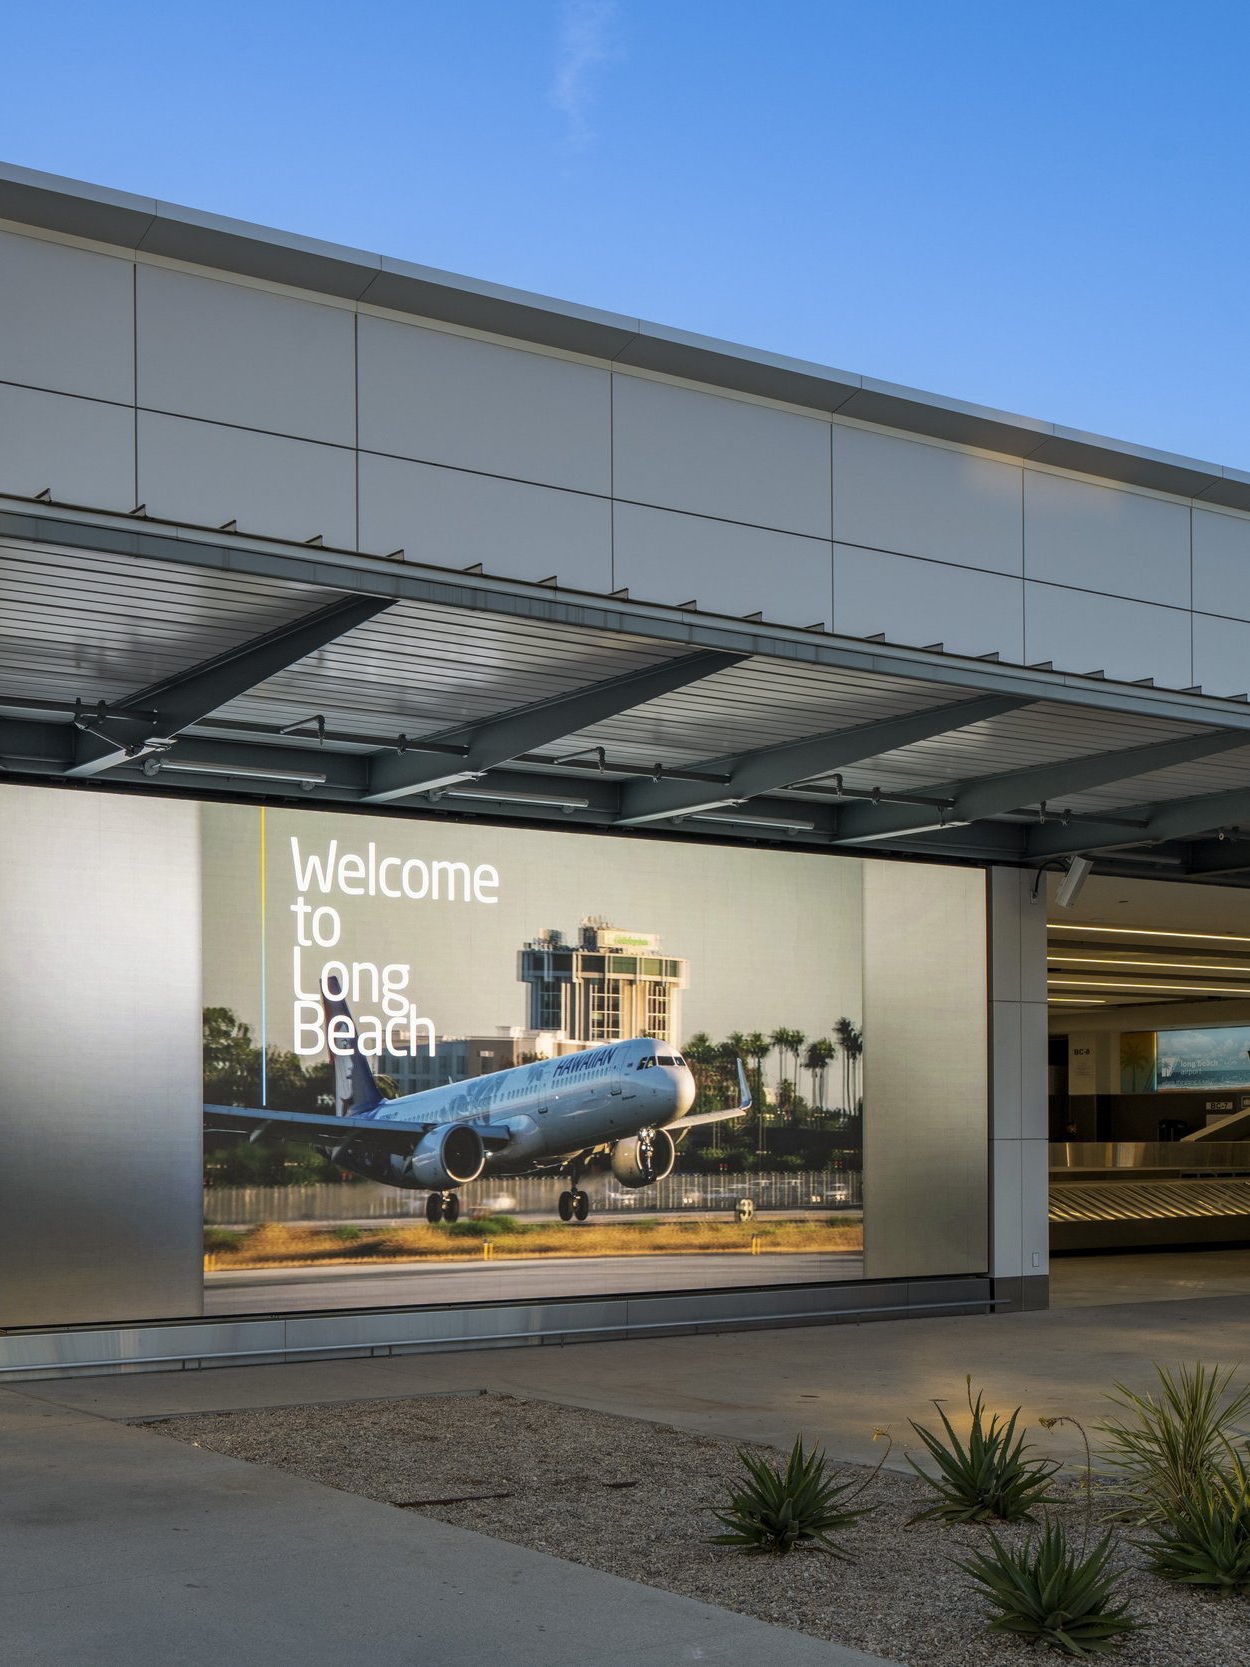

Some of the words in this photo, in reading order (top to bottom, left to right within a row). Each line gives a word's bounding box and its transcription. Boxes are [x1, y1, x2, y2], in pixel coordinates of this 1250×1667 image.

[291, 837, 499, 904] Welcome
[290, 896, 341, 947] to
[293, 946, 410, 1017] Long
[293, 1000, 436, 1057] Beach
[552, 1047, 618, 1078] HAWAIIAN
[1180, 1060, 1197, 1068] long
